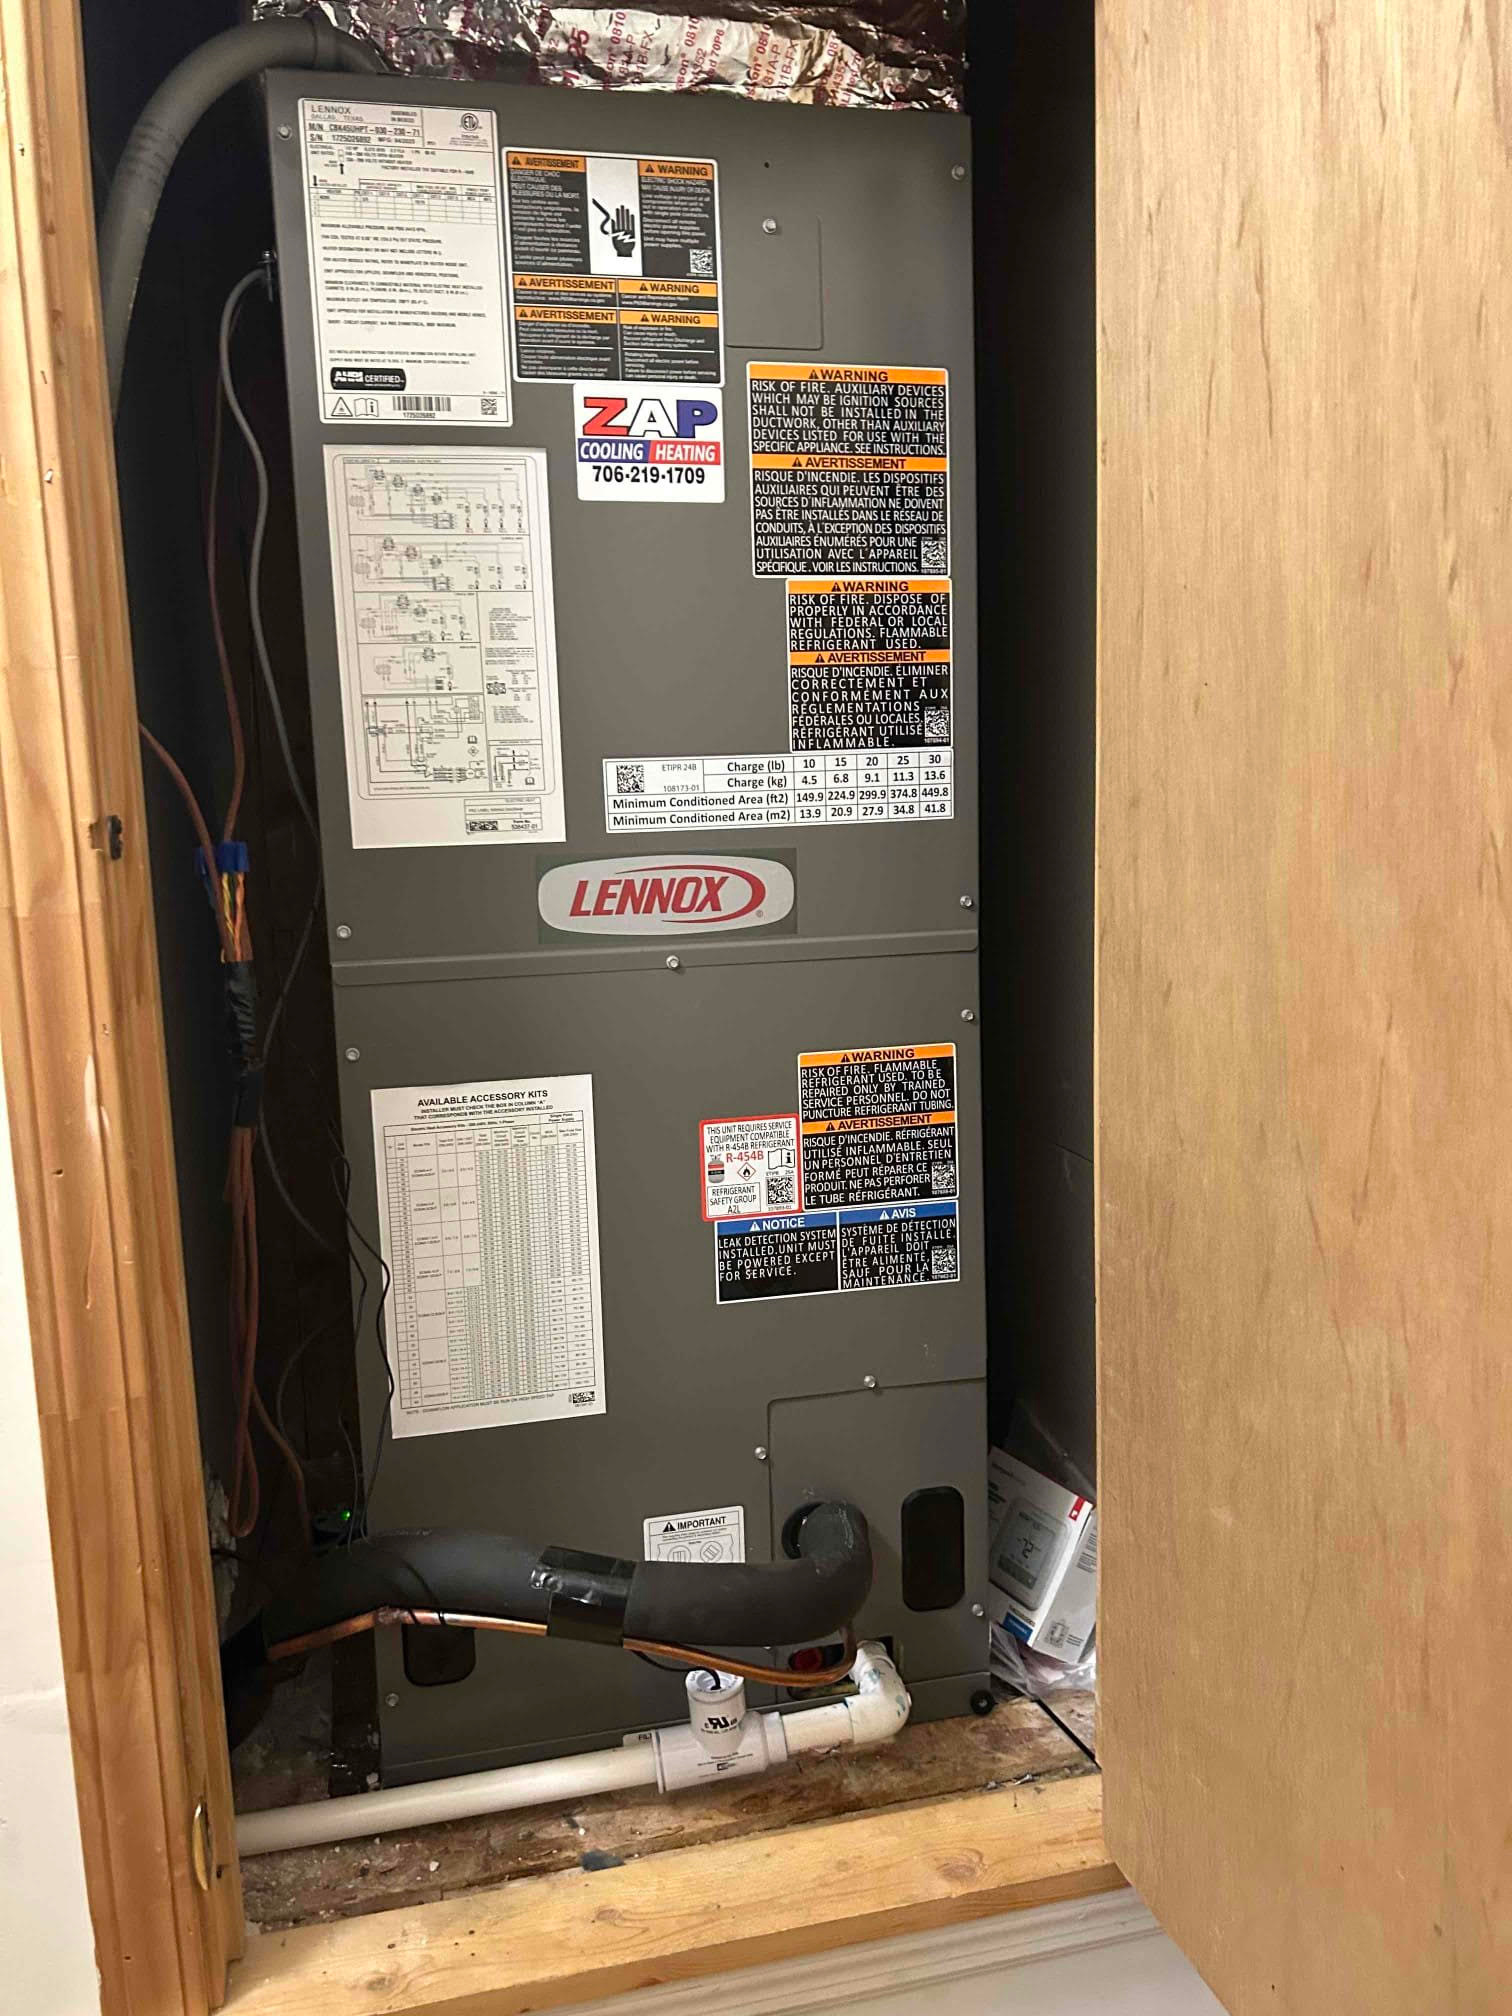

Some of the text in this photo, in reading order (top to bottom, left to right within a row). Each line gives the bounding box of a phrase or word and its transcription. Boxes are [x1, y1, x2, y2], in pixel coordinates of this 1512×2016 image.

[311, 104, 351, 115] LENNOX
[525, 157, 579, 168] AVERTISSEMENT
[657, 164, 708, 176] WARNING
[529, 279, 616, 290] AVERTISSEMENT
[650, 284, 700, 294] WARNING
[530, 310, 614, 321] AVERTISSEMENT
[651, 314, 701, 324] WARNING
[820, 369, 888, 382] WARNING
[752, 380, 944, 396] RISK OF FIRE. AUXILIARY DEVICES
[752, 393, 944, 409] WHICH MAY BE IGNITION SOURCES
[582, 396, 718, 439] ZAP
[752, 405, 944, 421] SHALL NOT BE INSTALLED IN THE
[580, 442, 716, 462] COOLING HEATING
[805, 458, 906, 469] AVERTISSEMENT
[842, 581, 909, 592] WARNING
[790, 594, 946, 605] RISK OF FIRE. DISPOSE OF
[790, 605, 947, 617] PROPERLY IN ACCORDANCE
[789, 616, 948, 628] WITH FEDERAL OR LOCAL
[791, 627, 947, 639] REGULATIONS. FLAMMABLE
[791, 638, 921, 650] REFRIGERANT USED.
[828, 651, 926, 662] AVERTISSEMENT
[727, 754, 941, 773] Charge (lb) 10 15 20 25 30
[727, 770, 946, 789] Charge (kg) 4.5 6.8 9.1 11.3 13.6
[613, 787, 949, 809] Minimum Conditioned Area (ft2) 149.9 224.9 299.9 374.8 449.8
[613, 803, 946, 826] Minimum Conditioned Area (m2) 13.9 20.9 27.9 34.8 41.8
[569, 876, 729, 917] LENNOX
[851, 1049, 915, 1062] WARNING
[801, 1059, 937, 1079] RISK OF FIRE. FLAMMABLE
[802, 1069, 941, 1089] REFRIGERANT USED. TO BE
[802, 1079, 946, 1099] REPAIRED ONLY BY TRAINED
[417, 1089, 548, 1107] AVAILABLE ACCESSORY KITS
[803, 1089, 950, 1109] SERVICE PERSONNEL. DO NOT
[803, 1099, 954, 1120] PUNCTURE REFRIGERANT TUBING.
[707, 1120, 792, 1135] THIS UNIT REQUIRES SERVICE
[838, 1114, 932, 1131] AVERTISSEMENT
[710, 1130, 789, 1145] EQUIPMENT COMPATIBLE
[706, 1139, 794, 1153] WITH R-454B REFRIGERANT
[726, 1151, 764, 1163] R-454B
[712, 1186, 755, 1196] REFRIGERANT
[710, 1194, 757, 1205] SAFETY GROUP
[727, 1205, 741, 1214] A2L
[891, 1208, 916, 1219] AVIS
[762, 1217, 805, 1231] NOTICE
[718, 1229, 836, 1249] LEAK DETECTION SYSTEM
[719, 1251, 835, 1271] BE POWERED EXCEPT
[720, 1266, 798, 1282] FOR SERVICE.
[677, 1516, 726, 1530] IMPORTANT
